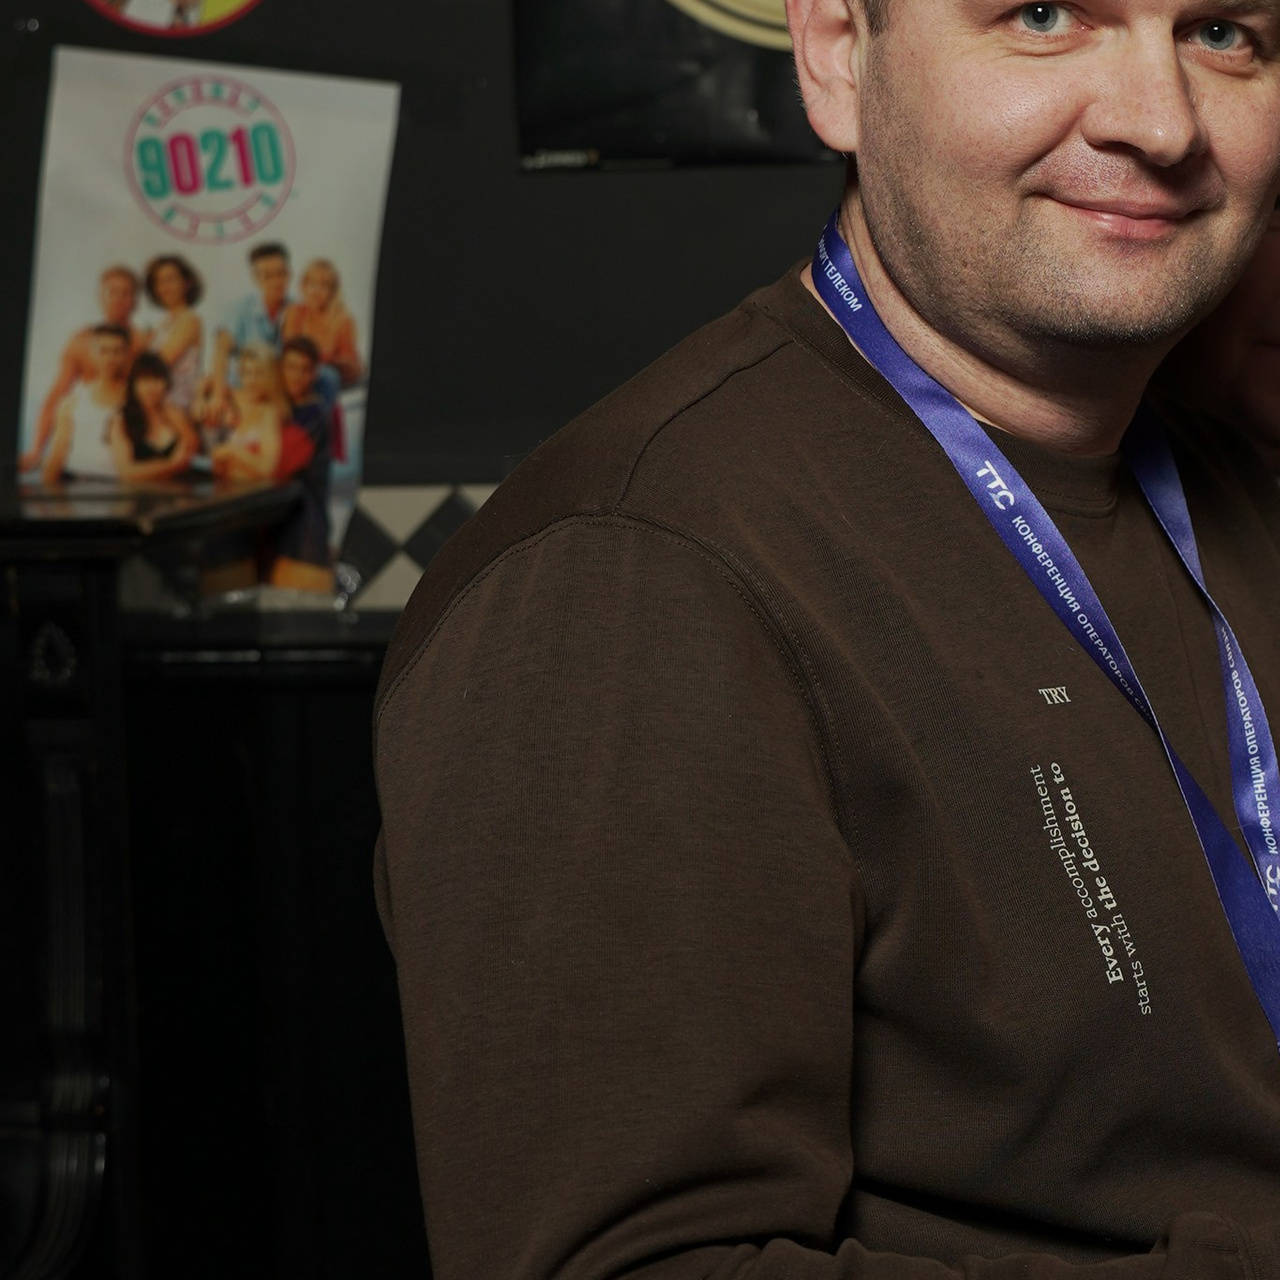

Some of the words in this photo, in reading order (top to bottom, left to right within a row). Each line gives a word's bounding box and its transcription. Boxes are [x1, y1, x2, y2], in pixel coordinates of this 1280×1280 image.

[137, 121, 285, 201] 90210
[822, 259, 863, 313] ТЕЛЕКОМ
[1011, 515, 1081, 613] КОНФЕРЕНЦИЯ
[1077, 613, 1134, 699] ОПЕРАТОРОВ
[1038, 685, 1072, 706] TRY
[1230, 669, 1259, 755] ОПЕРАТОРОВ
[1050, 762, 1065, 784] to
[1060, 786, 1101, 872] decision
[1249, 756, 1279, 855] КОНФЕРЕНЦИЯ
[1030, 764, 1098, 920] accomplishment
[1095, 875, 1118, 911] the
[1265, 863, 1280, 912] ТС
[1091, 921, 1124, 984] Every
[1110, 913, 1136, 958] with
[1131, 959, 1152, 1015] starts
